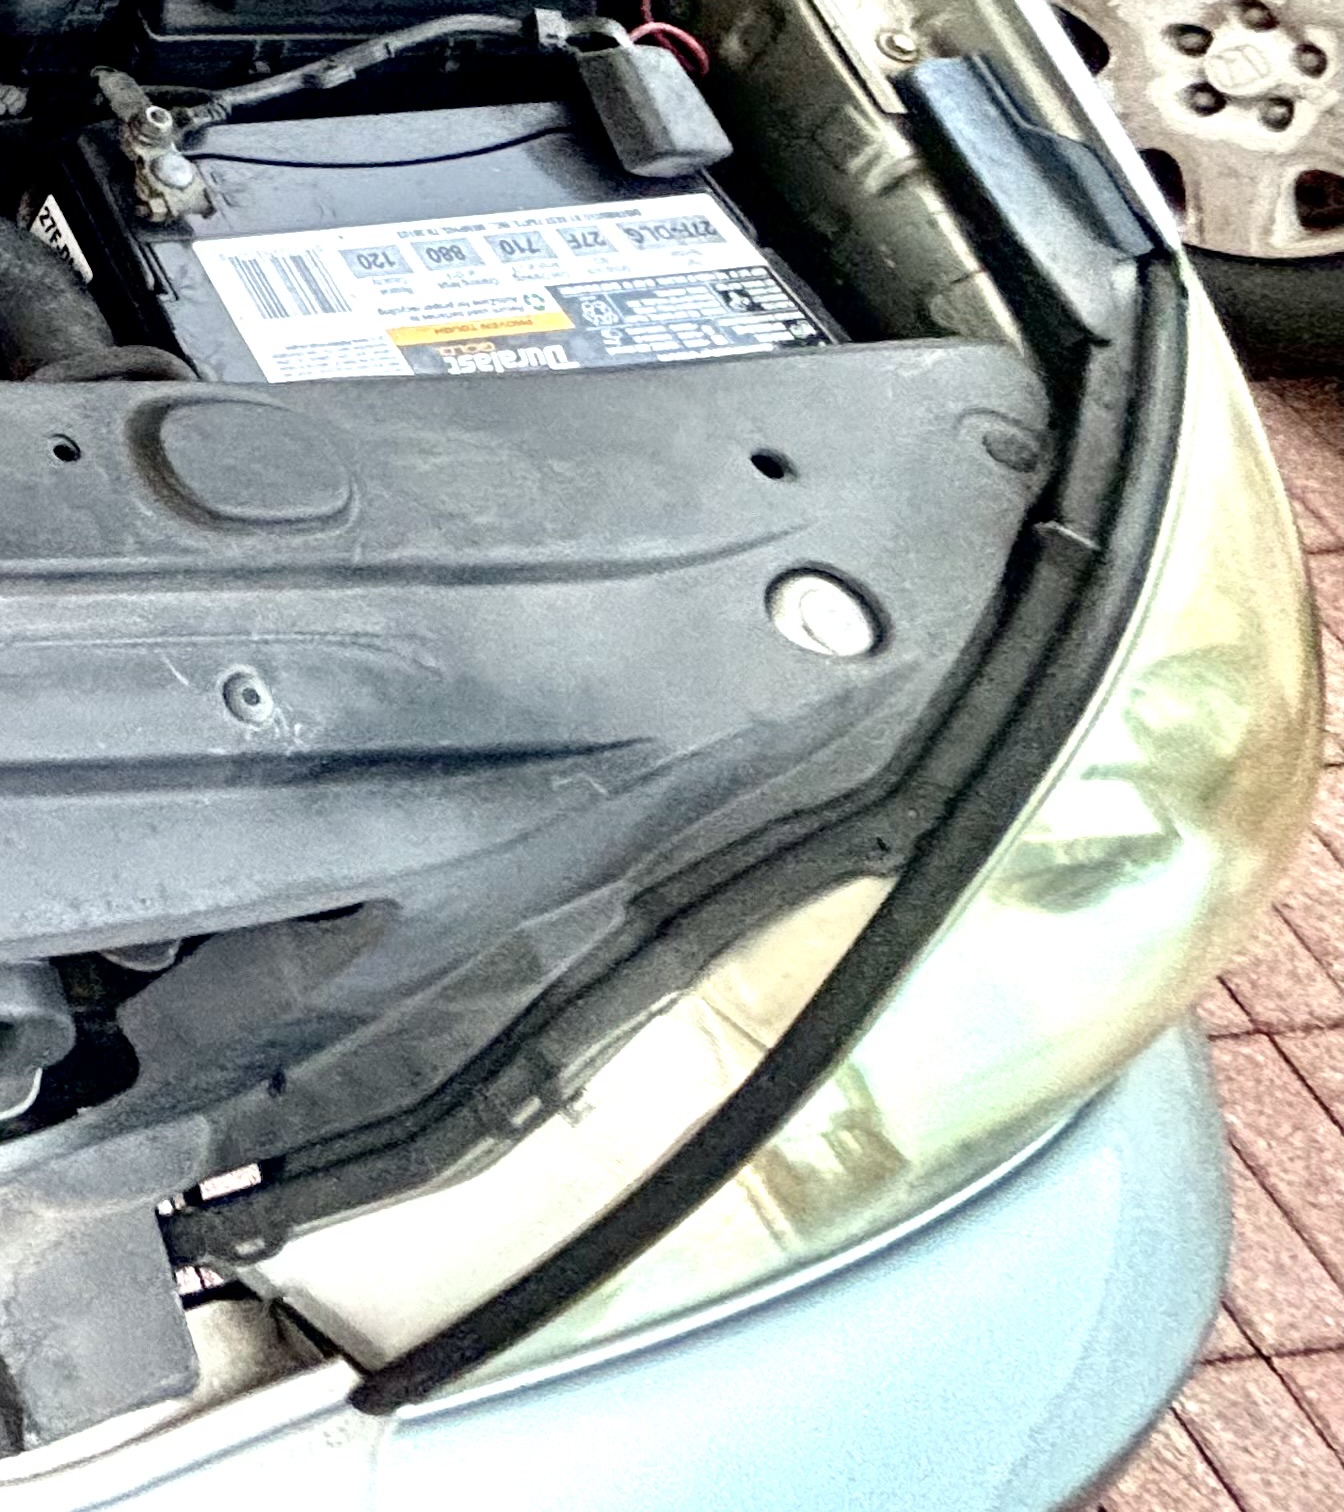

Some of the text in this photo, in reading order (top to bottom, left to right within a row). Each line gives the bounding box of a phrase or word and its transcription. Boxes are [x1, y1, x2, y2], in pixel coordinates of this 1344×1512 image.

[563, 230, 607, 251] 27F
[624, 221, 718, 246] 27F-DLG
[425, 244, 466, 264] 880
[499, 237, 541, 256] 710
[356, 251, 396, 270] 120
[434, 319, 533, 335] PROVEN TOUGH
[435, 341, 496, 356] GOLD
[443, 344, 580, 375] Duralast
